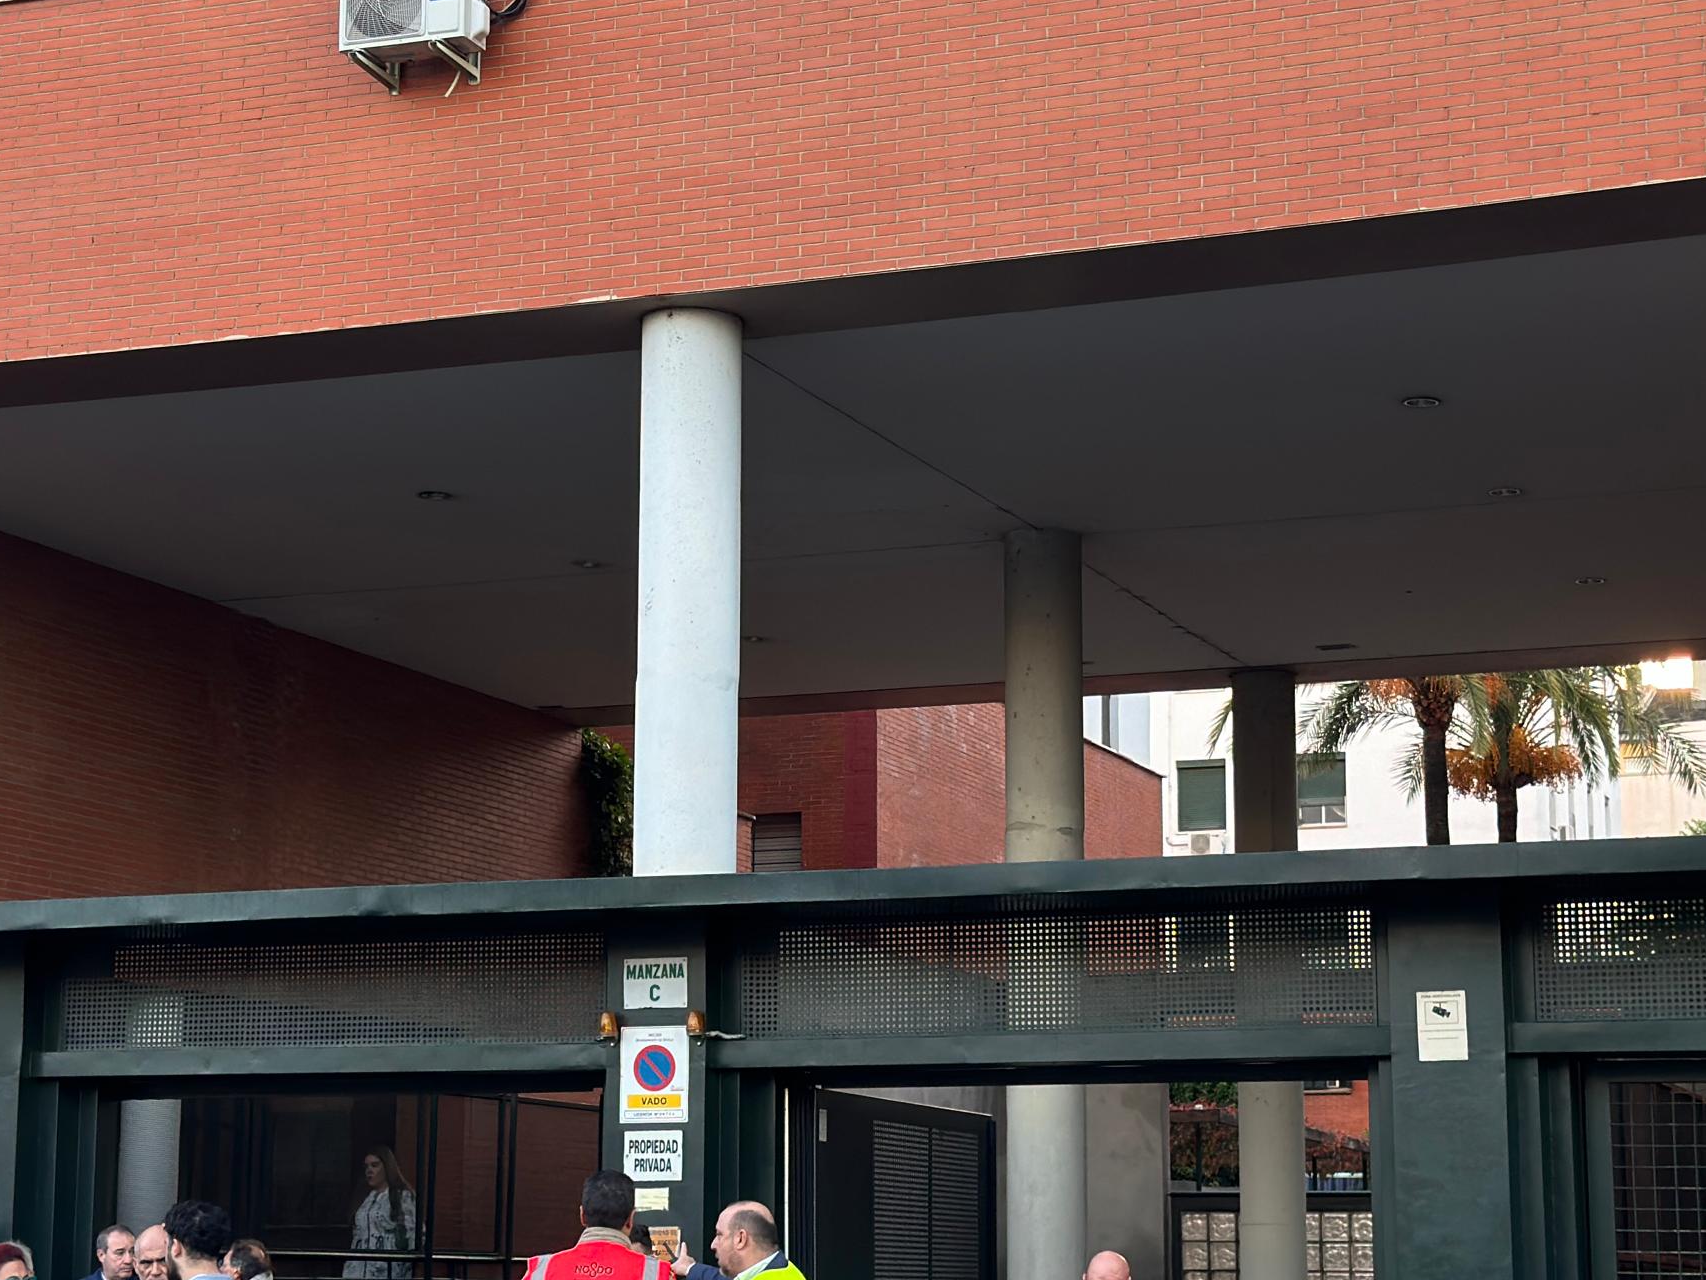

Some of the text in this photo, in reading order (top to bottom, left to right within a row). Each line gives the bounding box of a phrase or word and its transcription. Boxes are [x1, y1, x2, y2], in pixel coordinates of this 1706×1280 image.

[626, 963, 684, 980] MANZANA
[649, 984, 660, 1001] C
[641, 1097, 667, 1105] VADO
[628, 1139, 678, 1154] PROPIEDAD
[634, 1158, 672, 1172] PRIVADA
